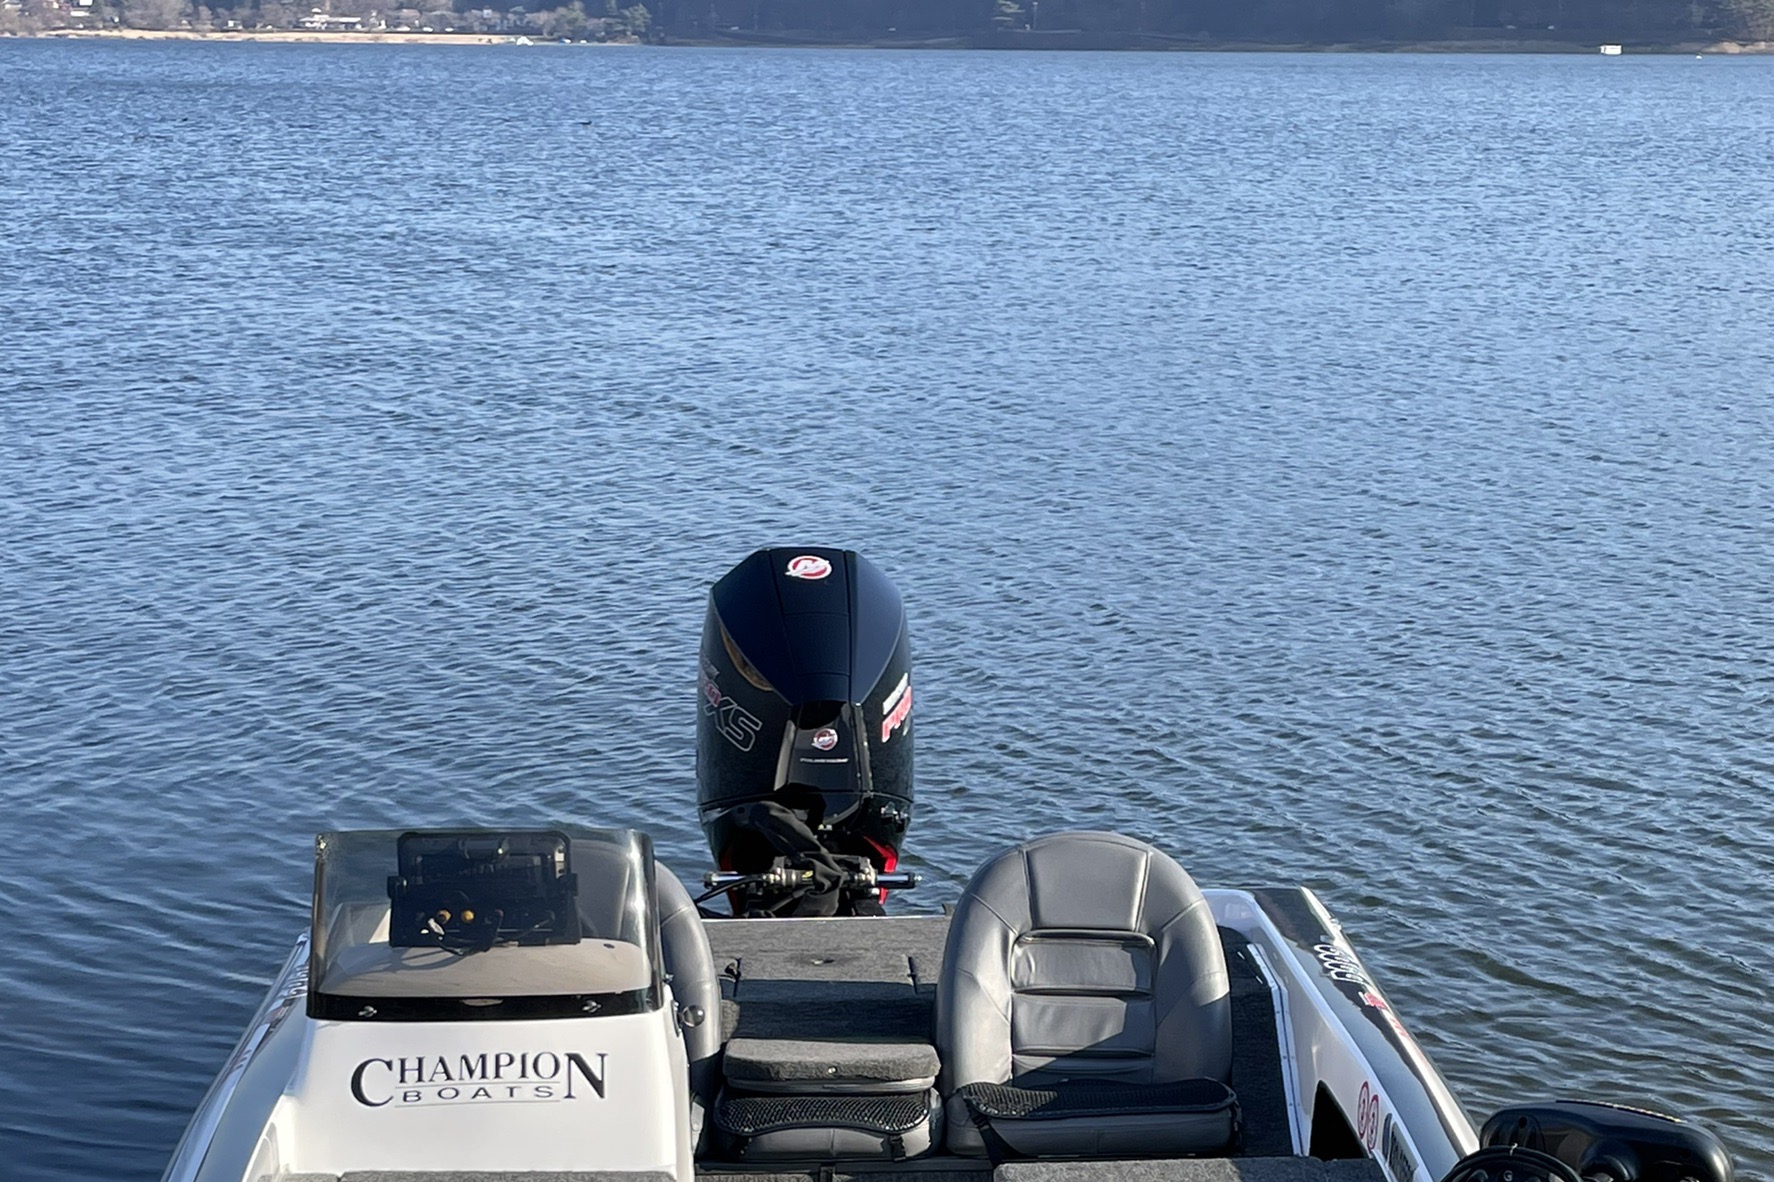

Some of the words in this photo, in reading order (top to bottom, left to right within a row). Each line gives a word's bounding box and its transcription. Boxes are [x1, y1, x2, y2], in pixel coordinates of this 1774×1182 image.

[703, 696, 763, 752] XS
[350, 1051, 609, 1108] CHAMPION
[402, 1085, 555, 1104] BOATS
